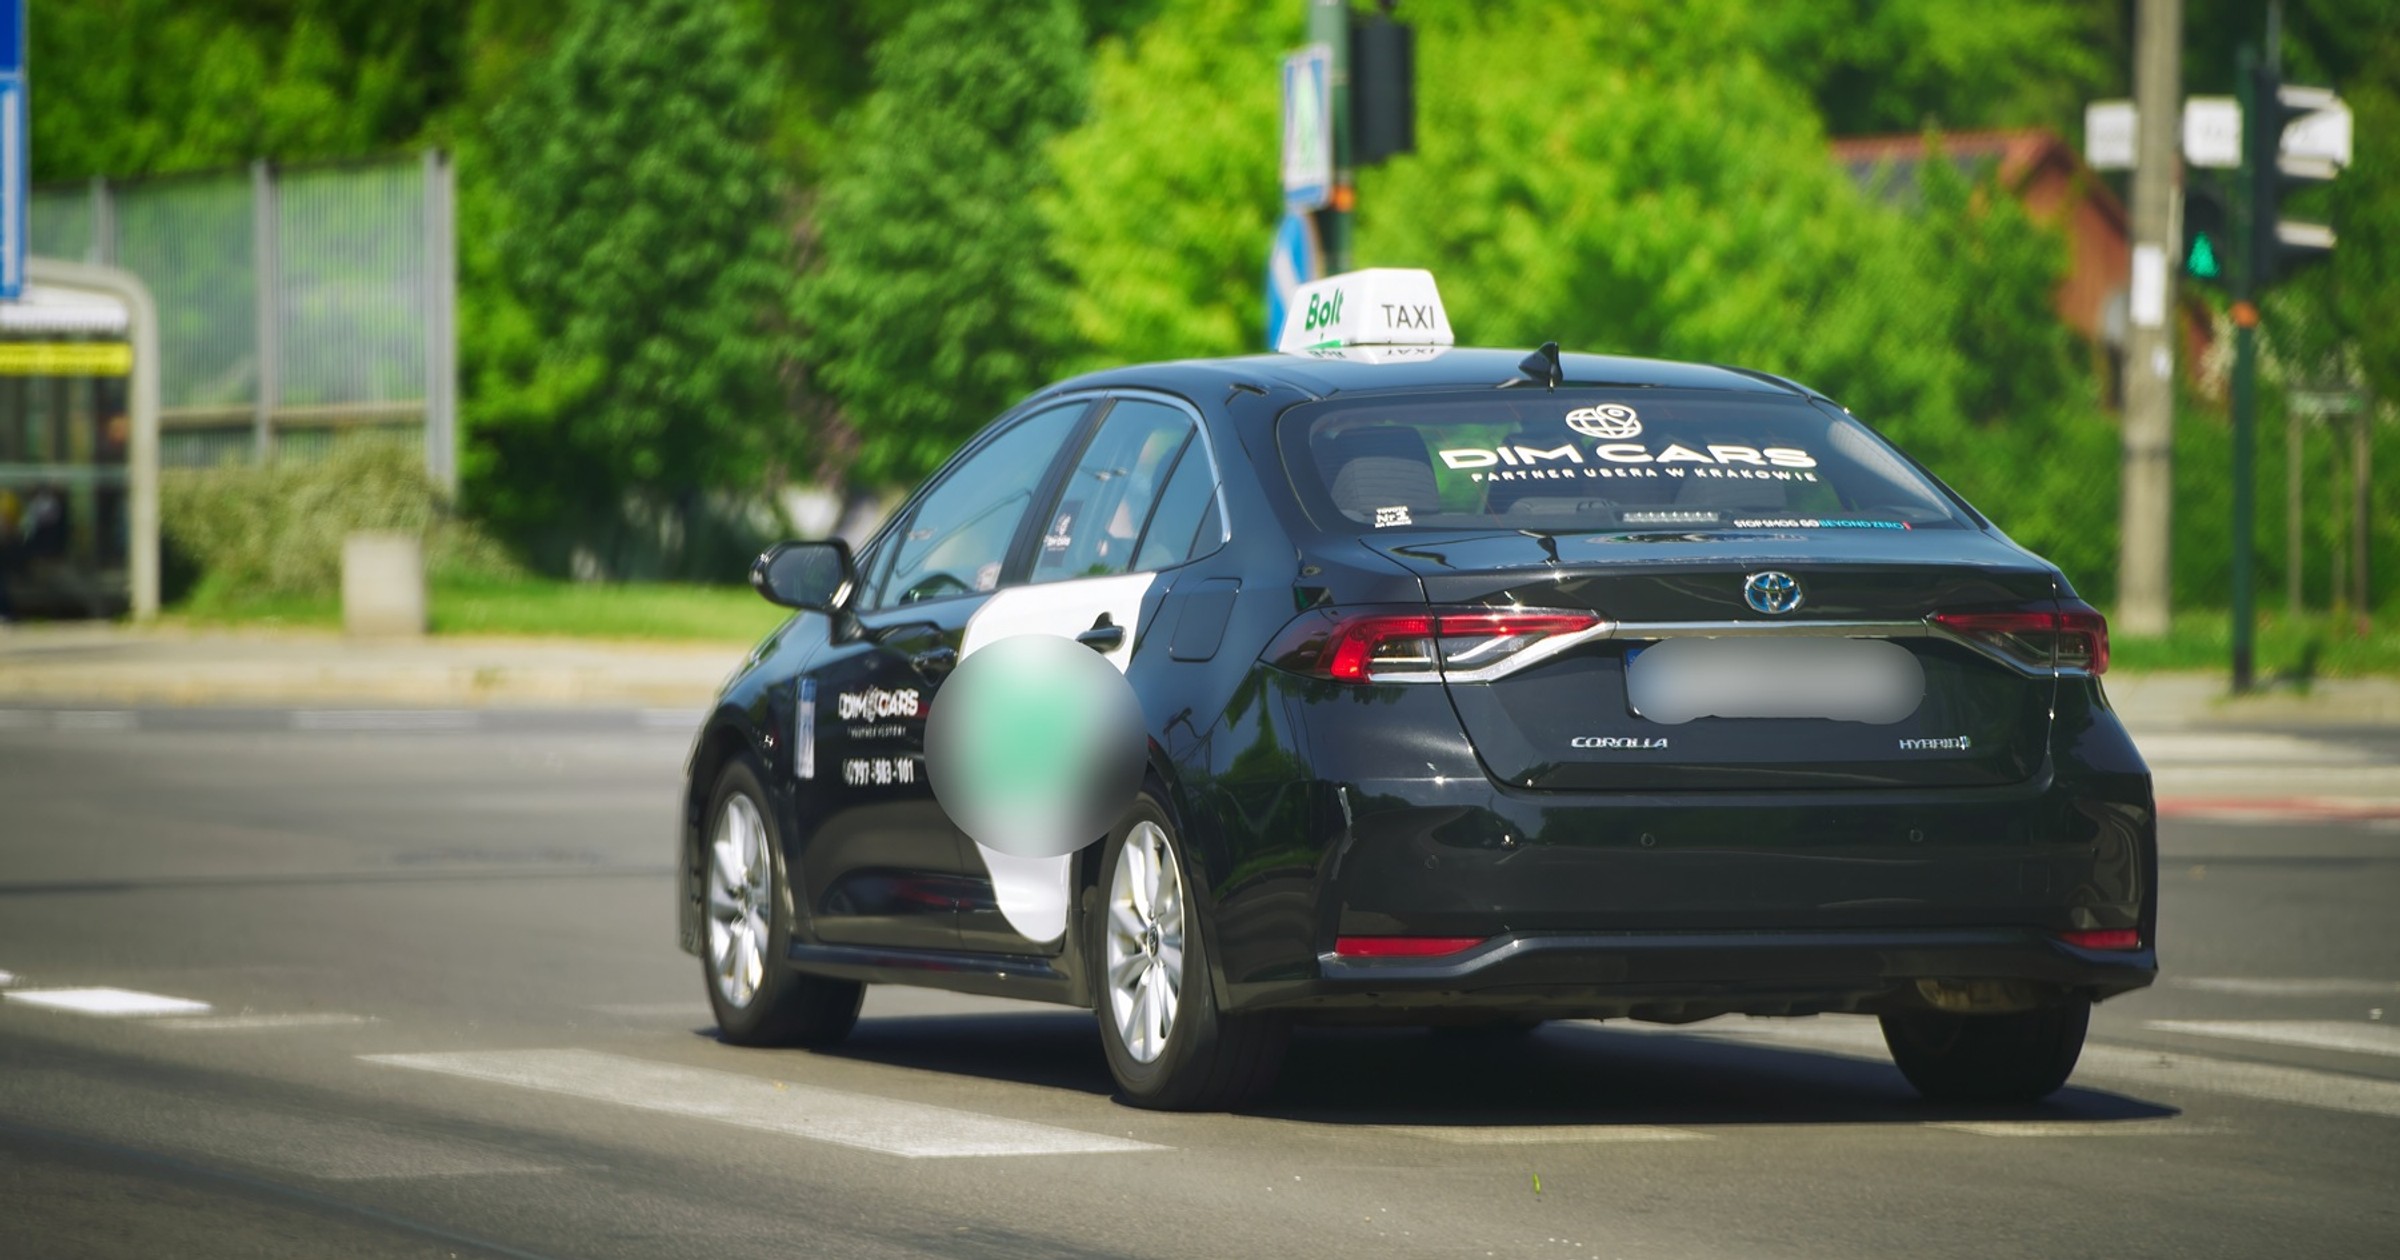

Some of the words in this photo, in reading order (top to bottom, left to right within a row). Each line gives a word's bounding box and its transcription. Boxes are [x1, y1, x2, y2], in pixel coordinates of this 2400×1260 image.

[1305, 287, 1344, 332] Bolt
[1381, 303, 1435, 329] TAXI
[1438, 443, 1584, 470] DIM
[1596, 443, 1818, 468] CARS
[1471, 468, 1576, 483] PARTNER
[1583, 467, 1658, 479] UBERA
[1665, 467, 1684, 478] W
[1693, 467, 1818, 482] KRAKOWIE
[839, 692, 868, 719] DIM
[876, 688, 919, 717] CARS
[1571, 736, 1668, 749] COROLLA
[1899, 738, 1960, 750] HYBRID
